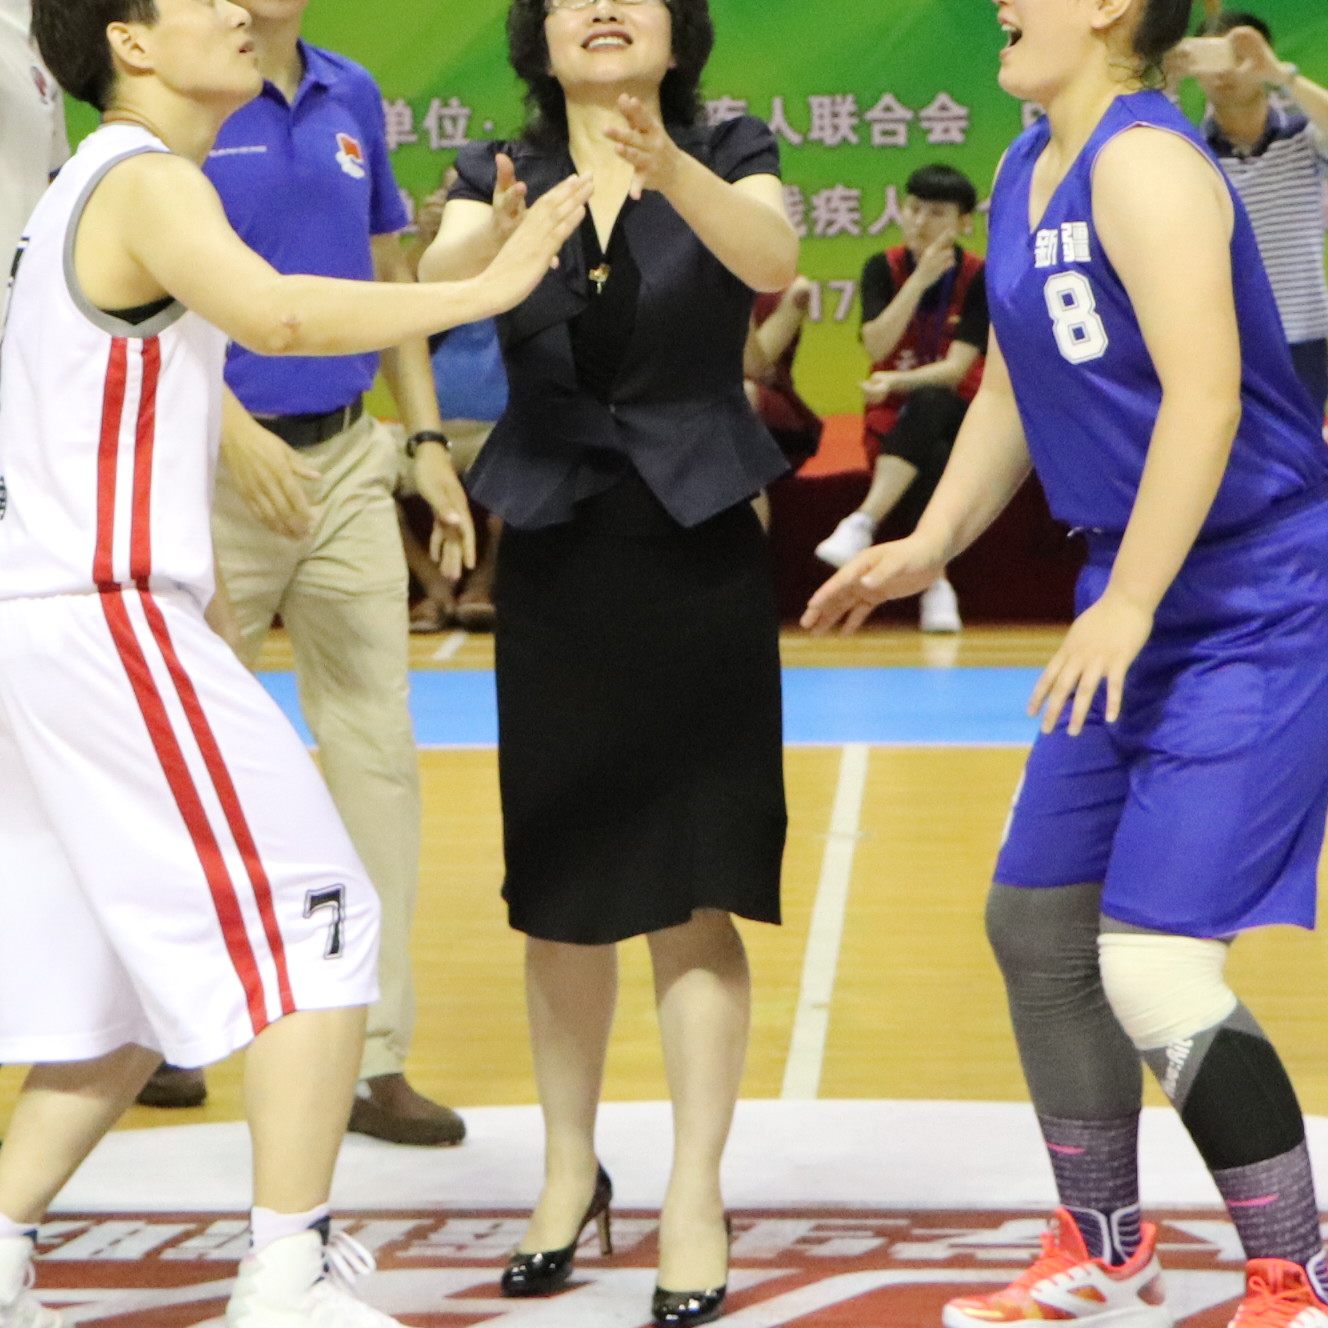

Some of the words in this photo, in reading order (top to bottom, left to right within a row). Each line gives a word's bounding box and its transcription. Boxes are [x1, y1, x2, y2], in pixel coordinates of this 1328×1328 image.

[1033, 220, 1092, 269] 新疆
[1043, 269, 1109, 365] 8
[302, 882, 346, 961] 7
